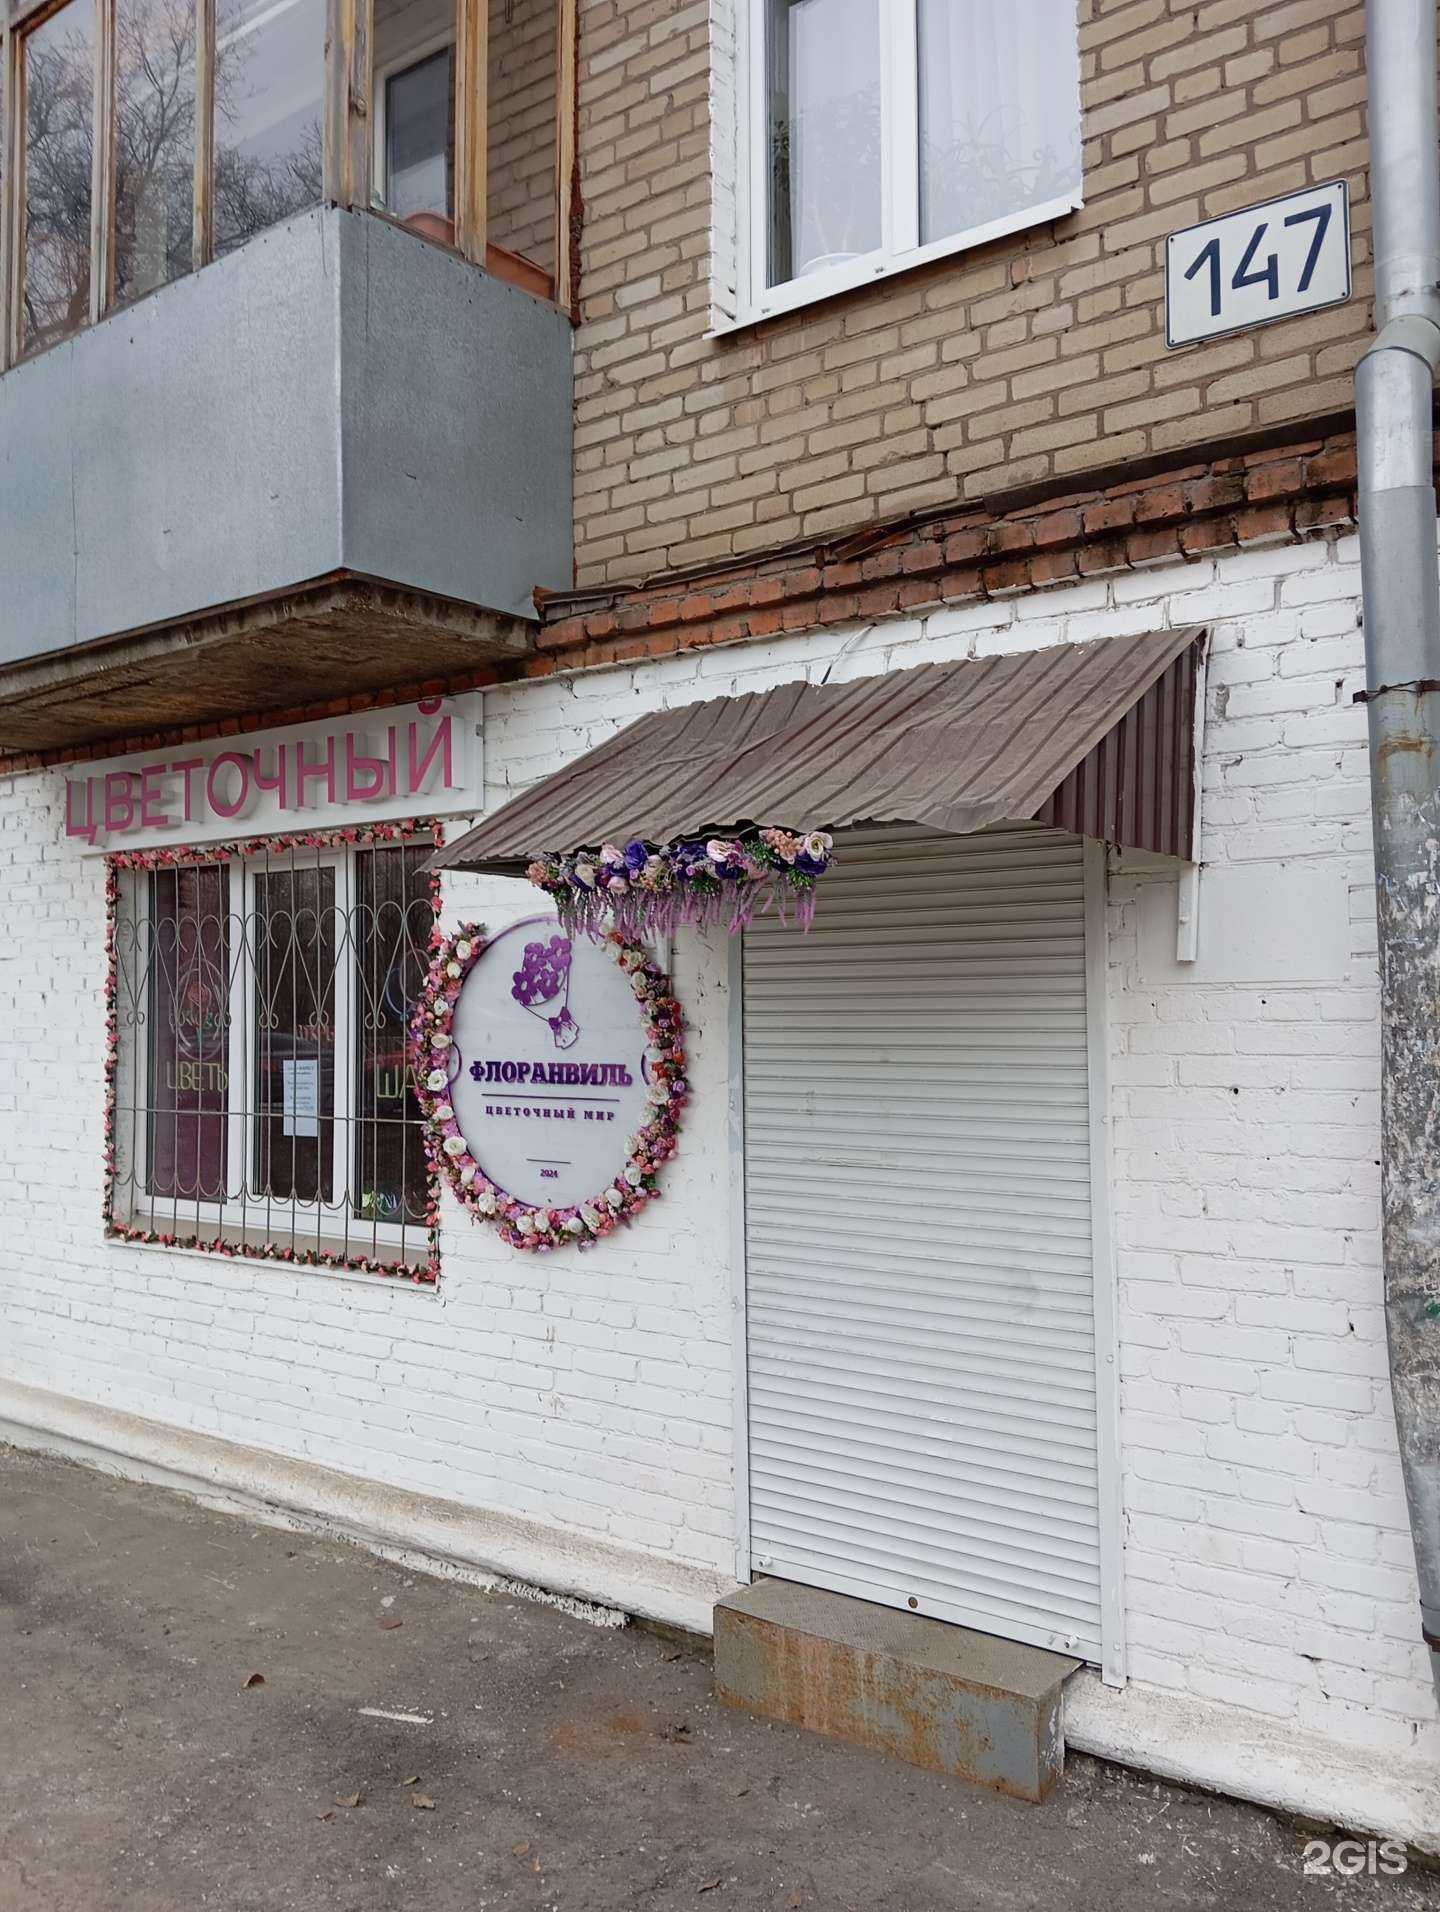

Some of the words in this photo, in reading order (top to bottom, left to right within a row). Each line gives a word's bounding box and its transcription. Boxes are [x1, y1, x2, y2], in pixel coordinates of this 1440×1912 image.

[1184, 203, 1332, 317] 147
[65, 699, 455, 846] ЦВЕТОЧНЫЙ
[469, 1060, 633, 1087] ФЛОРАНВИЛЬ
[485, 1105, 576, 1120] ЦВЕТОЧНЫЙ
[583, 1109, 615, 1121] МИР
